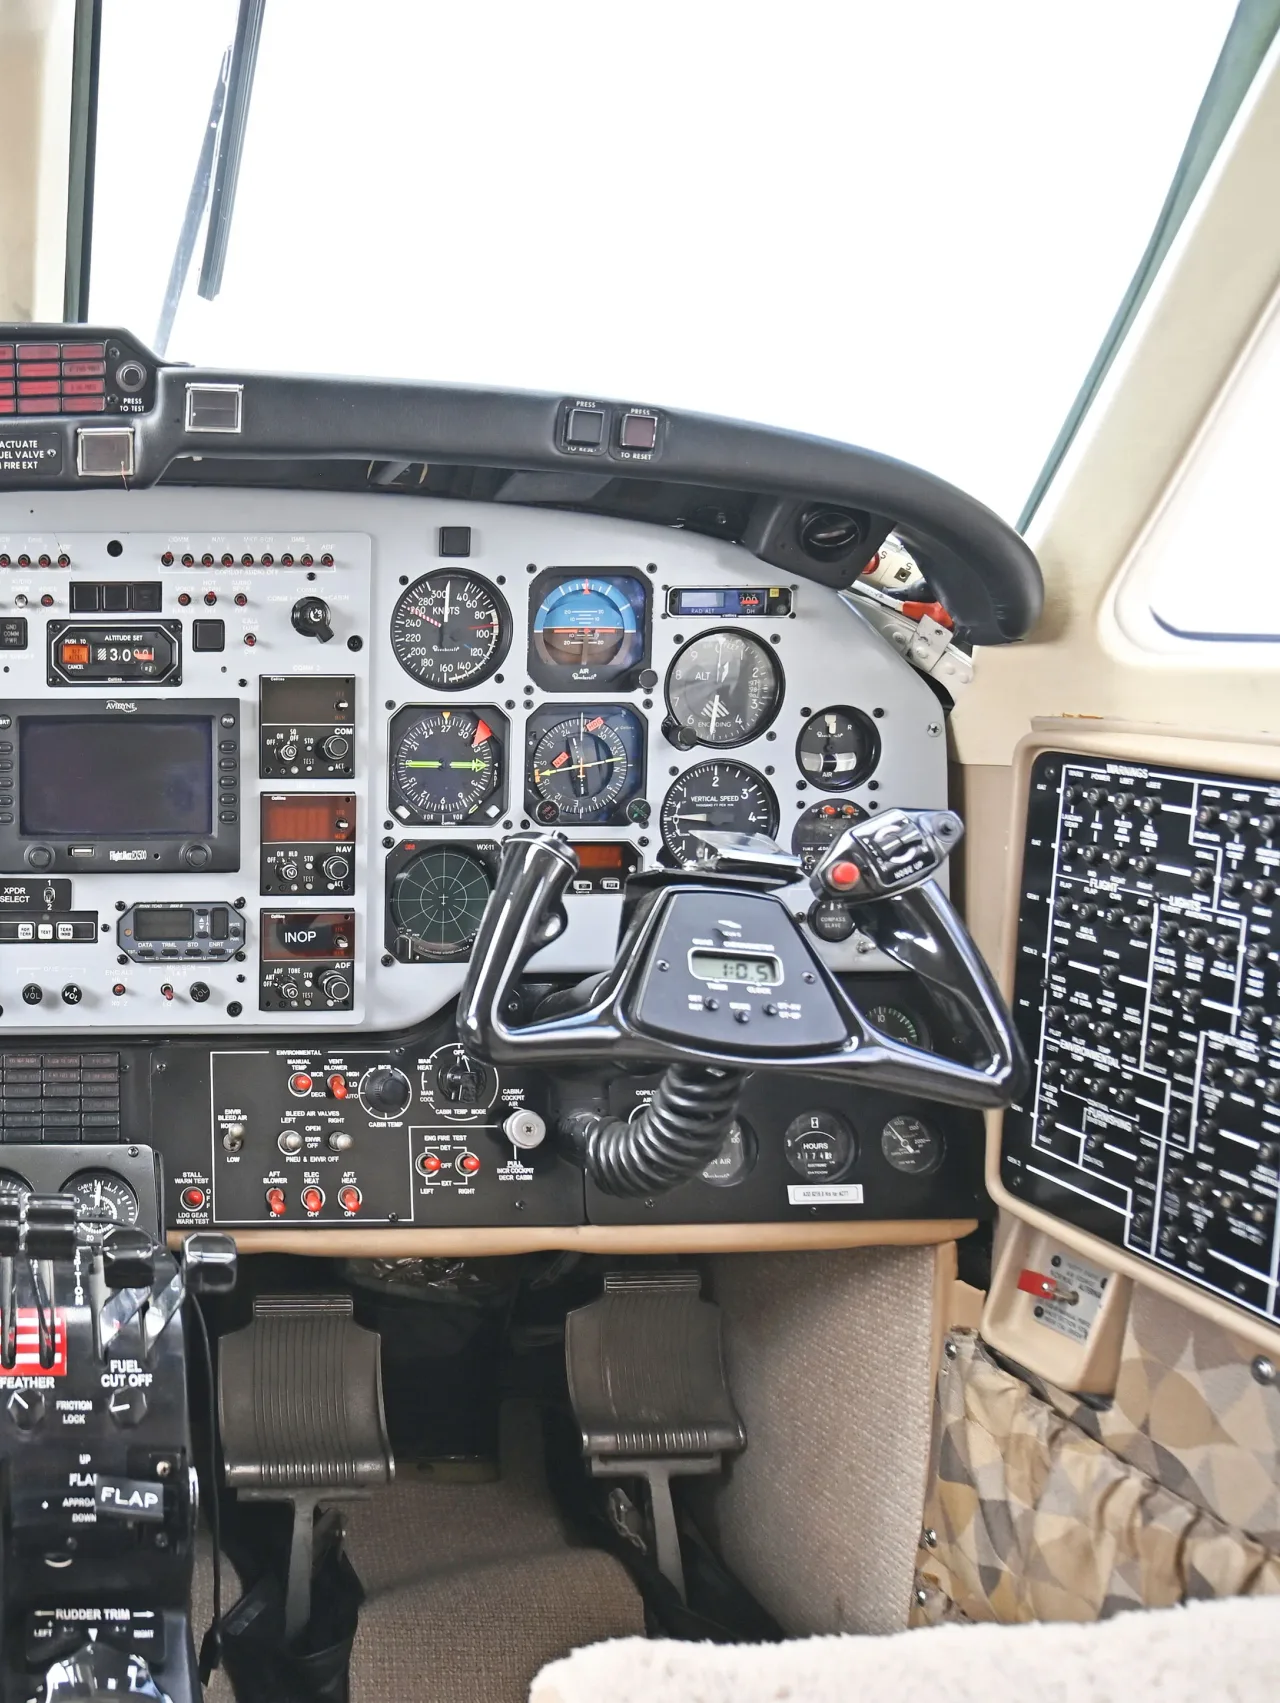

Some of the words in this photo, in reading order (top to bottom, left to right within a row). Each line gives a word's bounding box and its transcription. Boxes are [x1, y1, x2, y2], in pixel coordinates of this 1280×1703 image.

[123, 397, 142, 405] PRESS
[630, 408, 650, 416] PRESS
[15, 450, 44, 459] VALVE
[632, 452, 652, 461] RESET
[4, 461, 20, 470] FIRE
[22, 461, 38, 470] EXT
[405, 618, 422, 628] 240
[405, 633, 421, 643] 220
[695, 671, 710, 681] ALT
[105, 701, 137, 711] AVIDYNE
[1106, 763, 1149, 779] WARNINGS
[691, 795, 718, 803] VERTICAL
[335, 845, 352, 853] NAV
[1089, 878, 1120, 892] FLIGHT
[3, 887, 26, 895] XPDR
[0, 895, 30, 903] SELECT
[284, 930, 317, 943] INOP
[1059, 1040, 1120, 1069] ENVIRONMENTAL
[803, 1142, 828, 1150] HOURS
[110, 1360, 142, 1372] FUEL
[0, 1377, 55, 1389] FEATHER
[101, 1374, 125, 1387] CUT
[129, 1373, 152, 1387] OFF
[56, 1400, 92, 1410] FRICTION
[62, 1414, 85, 1424] LOCK
[79, 1454, 91, 1464] UP
[101, 1486, 159, 1509] FLAP
[56, 1608, 101, 1620] RUDDER
[103, 1608, 130, 1620] TRIM
